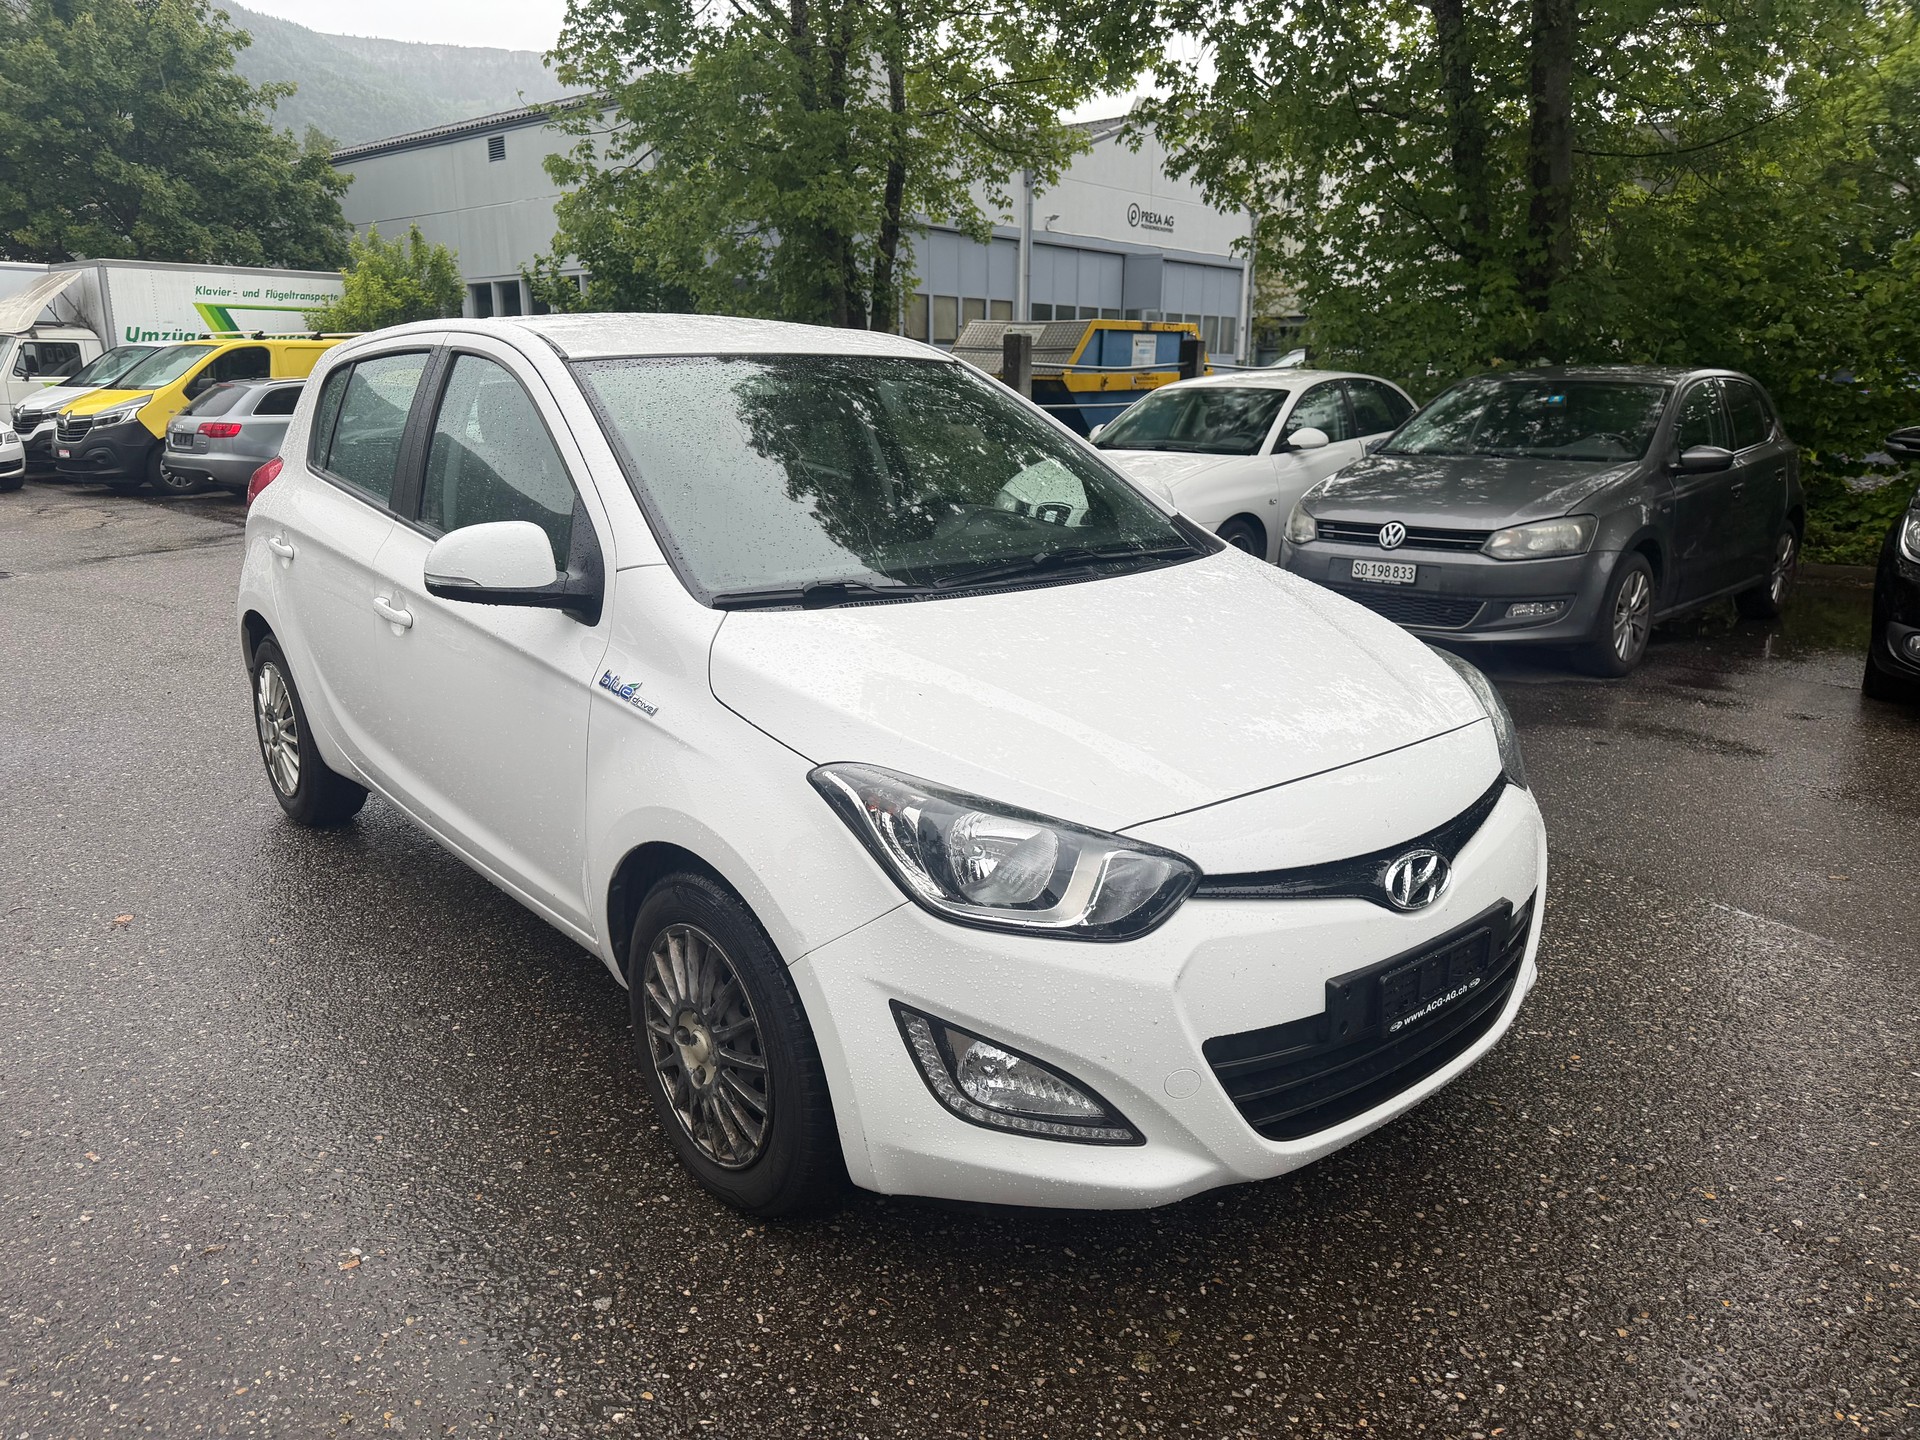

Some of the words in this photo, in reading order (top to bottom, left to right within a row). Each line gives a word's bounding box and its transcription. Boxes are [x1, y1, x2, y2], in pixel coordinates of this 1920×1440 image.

[1141, 211, 1162, 225] PREXA
[1164, 215, 1174, 227] AG
[242, 288, 260, 298] und
[599, 669, 636, 703] blue
[1403, 984, 1468, 1026] www.ACG-AG.ch
